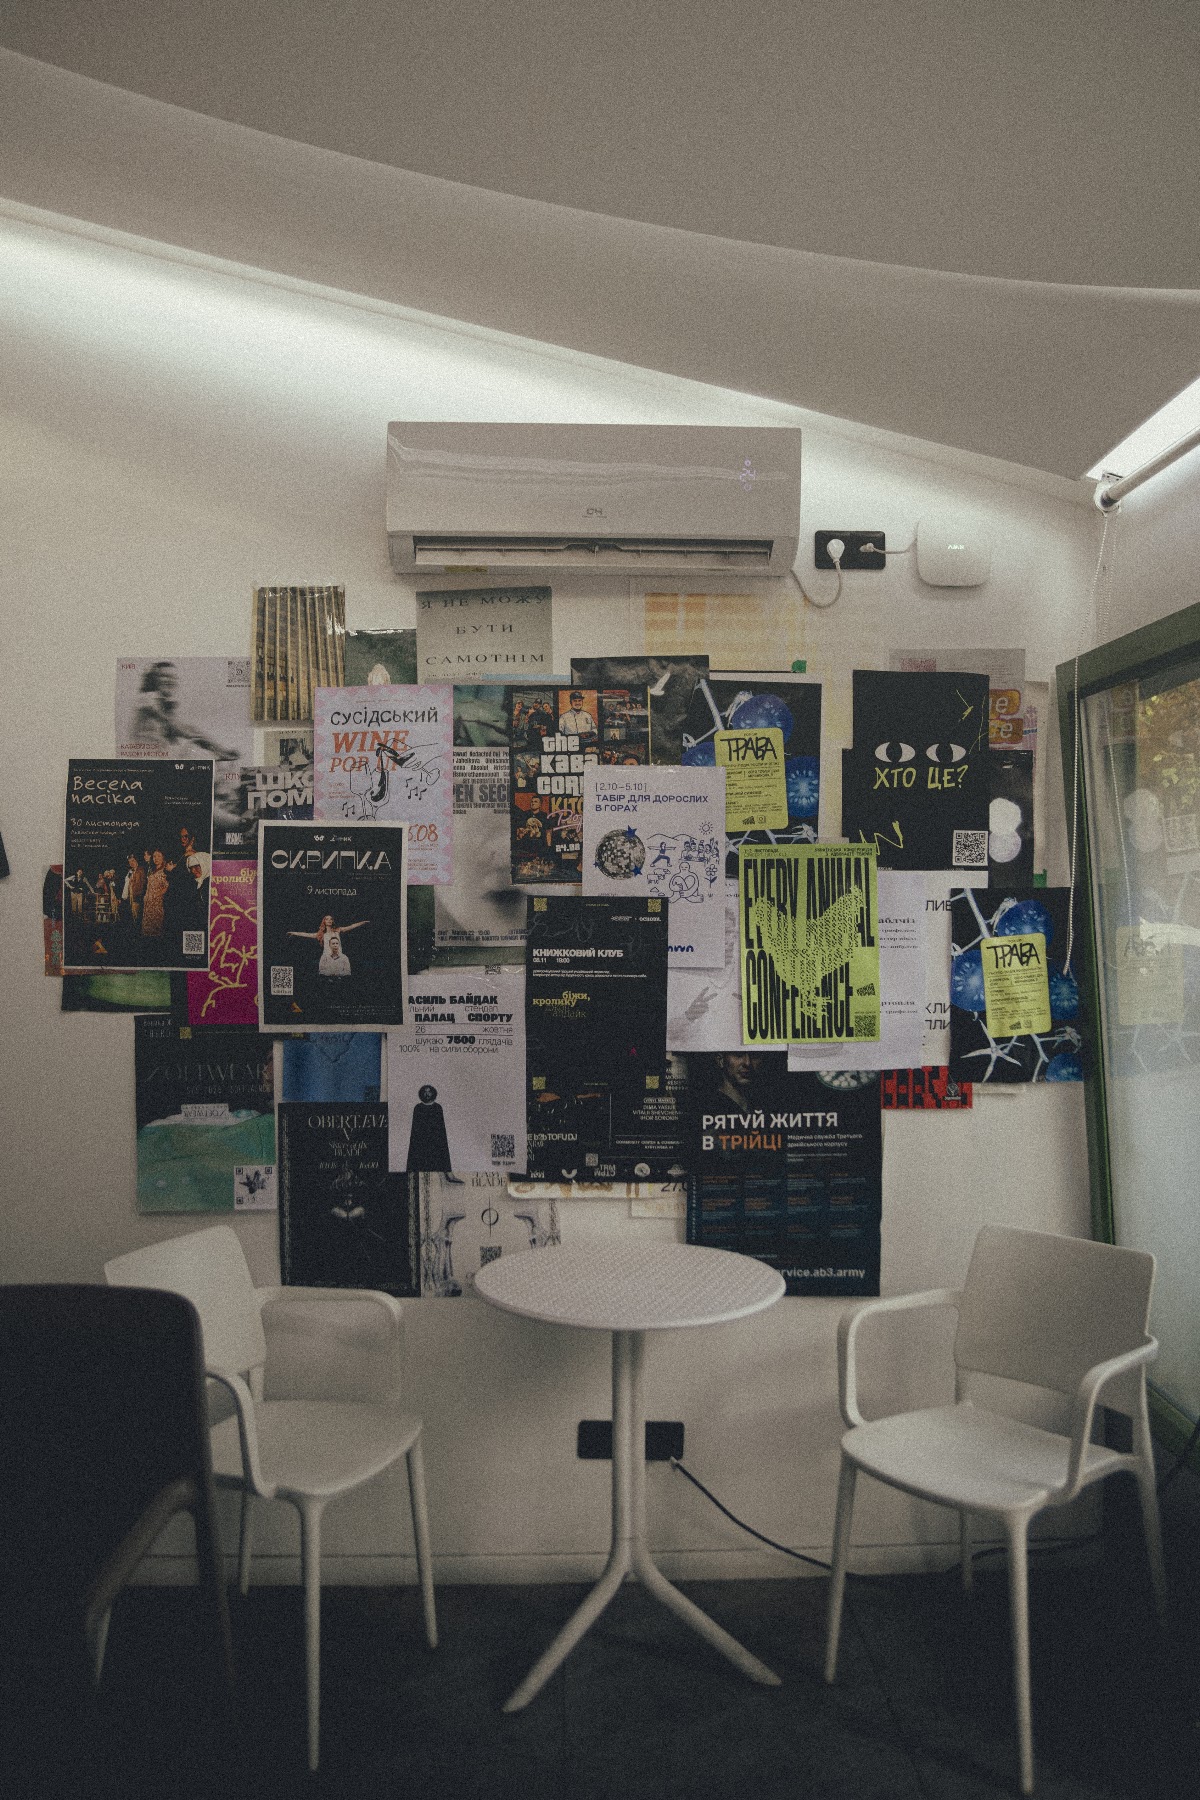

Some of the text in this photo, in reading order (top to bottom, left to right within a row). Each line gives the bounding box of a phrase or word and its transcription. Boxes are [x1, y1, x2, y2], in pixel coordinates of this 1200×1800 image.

[421, 595, 547, 609] Я НЕ МОЖУ
[456, 624, 513, 635] БУТИ
[425, 654, 544, 665] САМОТНІМ
[330, 707, 439, 727] сусідський
[331, 730, 410, 753] WINE
[542, 732, 580, 752] the
[719, 737, 778, 762] ТРАВА
[329, 755, 370, 773] POP
[73, 775, 143, 791] Весела
[872, 764, 969, 790] ХТО ЦЕ?
[536, 775, 584, 798] COR
[71, 790, 138, 805] пасіка
[595, 794, 709, 804] ТАБІР ДЛЯ ДОРОСЛИХ
[595, 804, 638, 812] В ГОРАХ
[71, 818, 141, 831] 30 листопада
[271, 849, 392, 870] СКРИПКА
[306, 885, 357, 897] 9 листопада
[743, 856, 875, 949] EVERY ANIMAL
[532, 947, 624, 958] КНИЖКОВИЙ КЛУБ
[986, 942, 1041, 969] ТРАВА
[449, 993, 498, 1006] БАЙДАК
[745, 949, 855, 1040] CONFERENCE
[532, 997, 577, 1008] кролику
[464, 1005, 499, 1014] стендап
[415, 1013, 513, 1024] ПАЛАЦ СПОРТУ
[415, 1025, 513, 1034] 26 жовтня
[415, 1035, 513, 1047] шукаю 7500 глядачів
[398, 1044, 499, 1055] 100% на сили оборони
[702, 1109, 839, 1130] РЯТУЙ ЖИТТЯ
[548, 1133, 568, 1141] TOFU
[702, 1131, 782, 1151] В ТРІЙЦІ
[824, 1141, 848, 1149] корпусу
[777, 1267, 866, 1279] rvice.ab3.army
